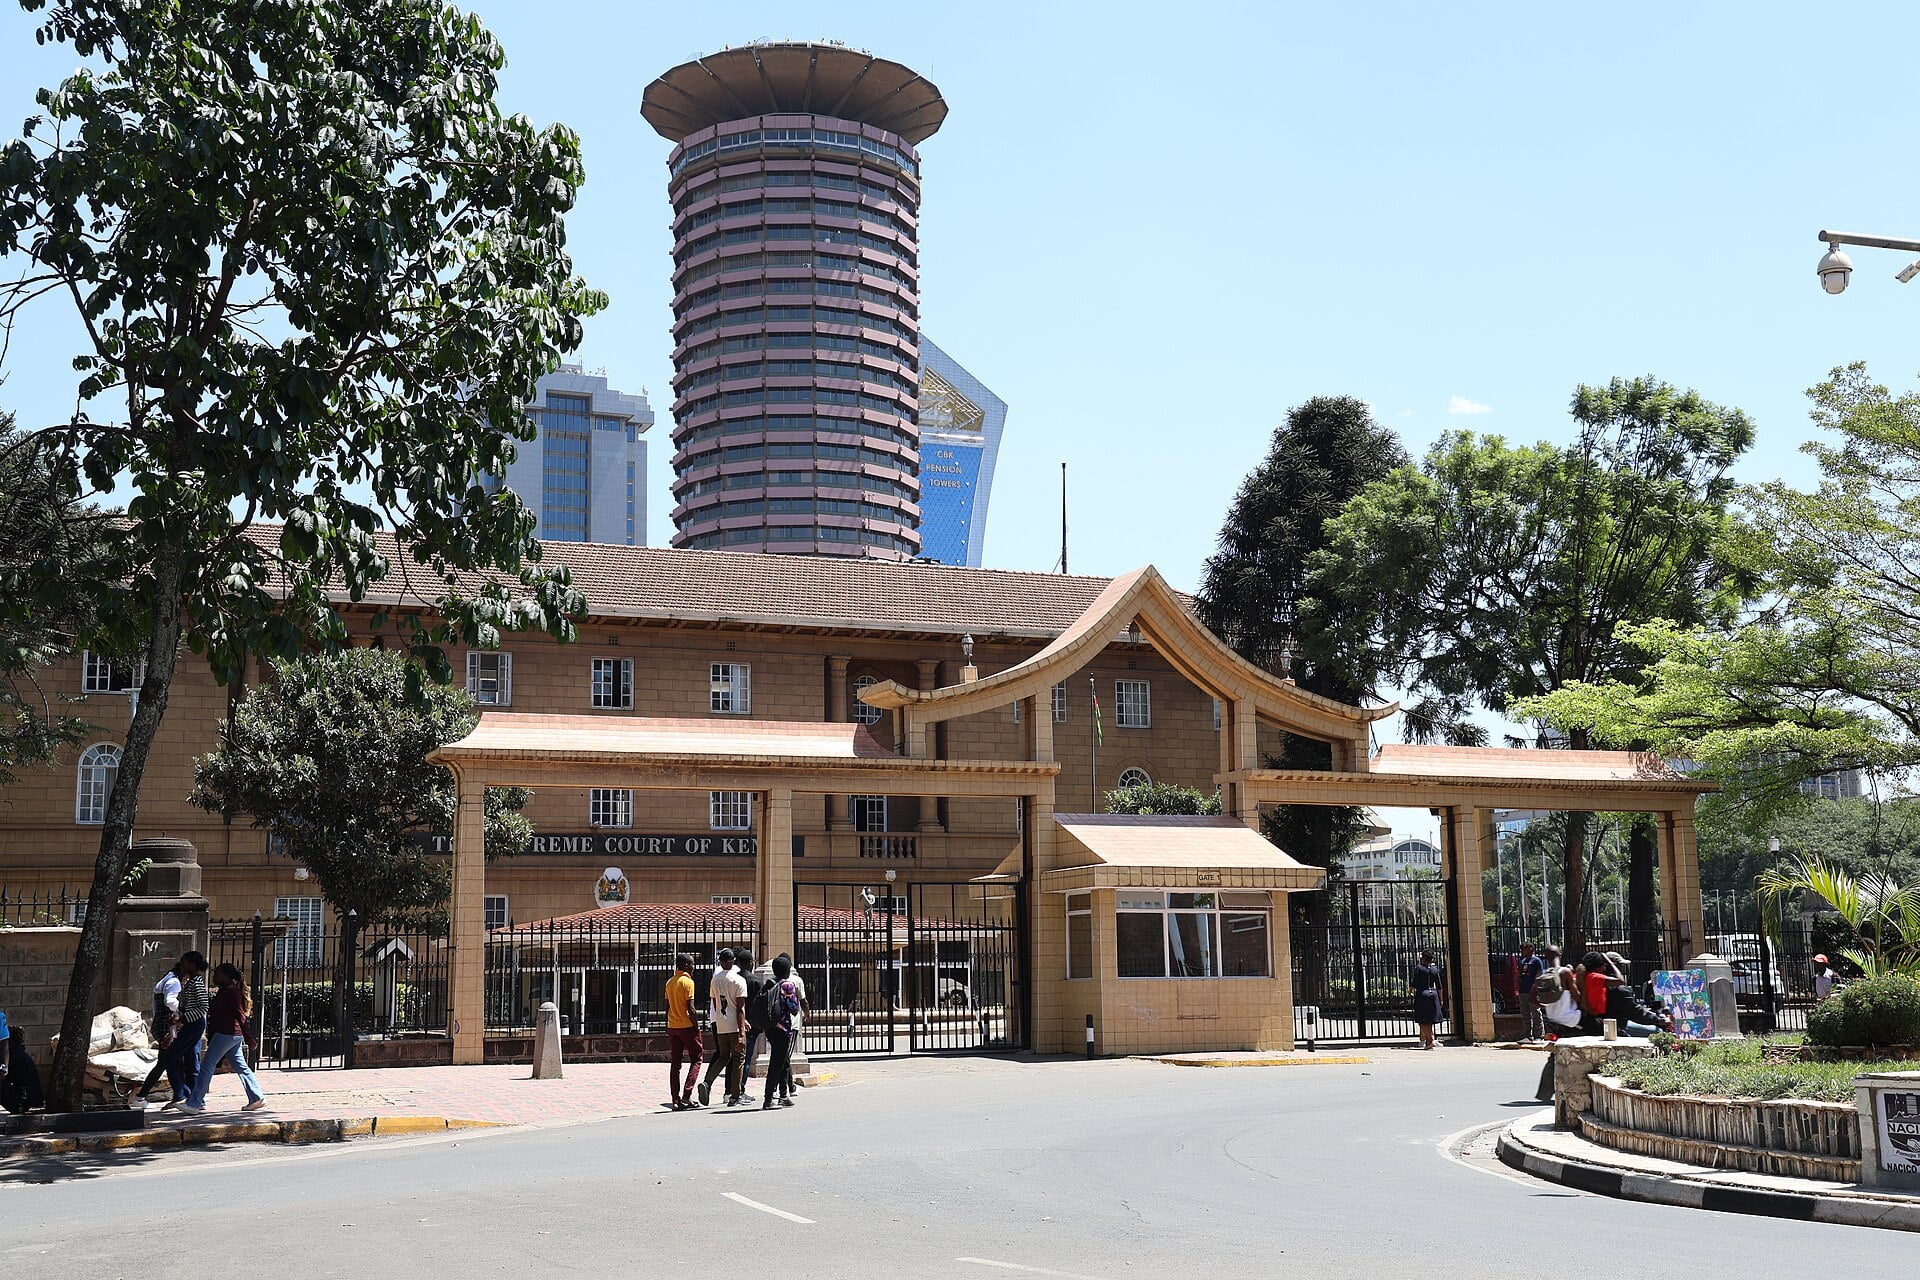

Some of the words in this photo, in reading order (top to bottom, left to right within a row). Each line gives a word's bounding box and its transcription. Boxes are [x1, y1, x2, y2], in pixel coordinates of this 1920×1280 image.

[936, 450, 954, 459] CBK
[925, 463, 962, 474] PENSION
[929, 478, 962, 489] TOWERS
[520, 836, 594, 853] REME
[604, 837, 676, 854] COURT
[685, 838, 712, 854] OF
[1886, 1163, 1918, 1174] NACICO
